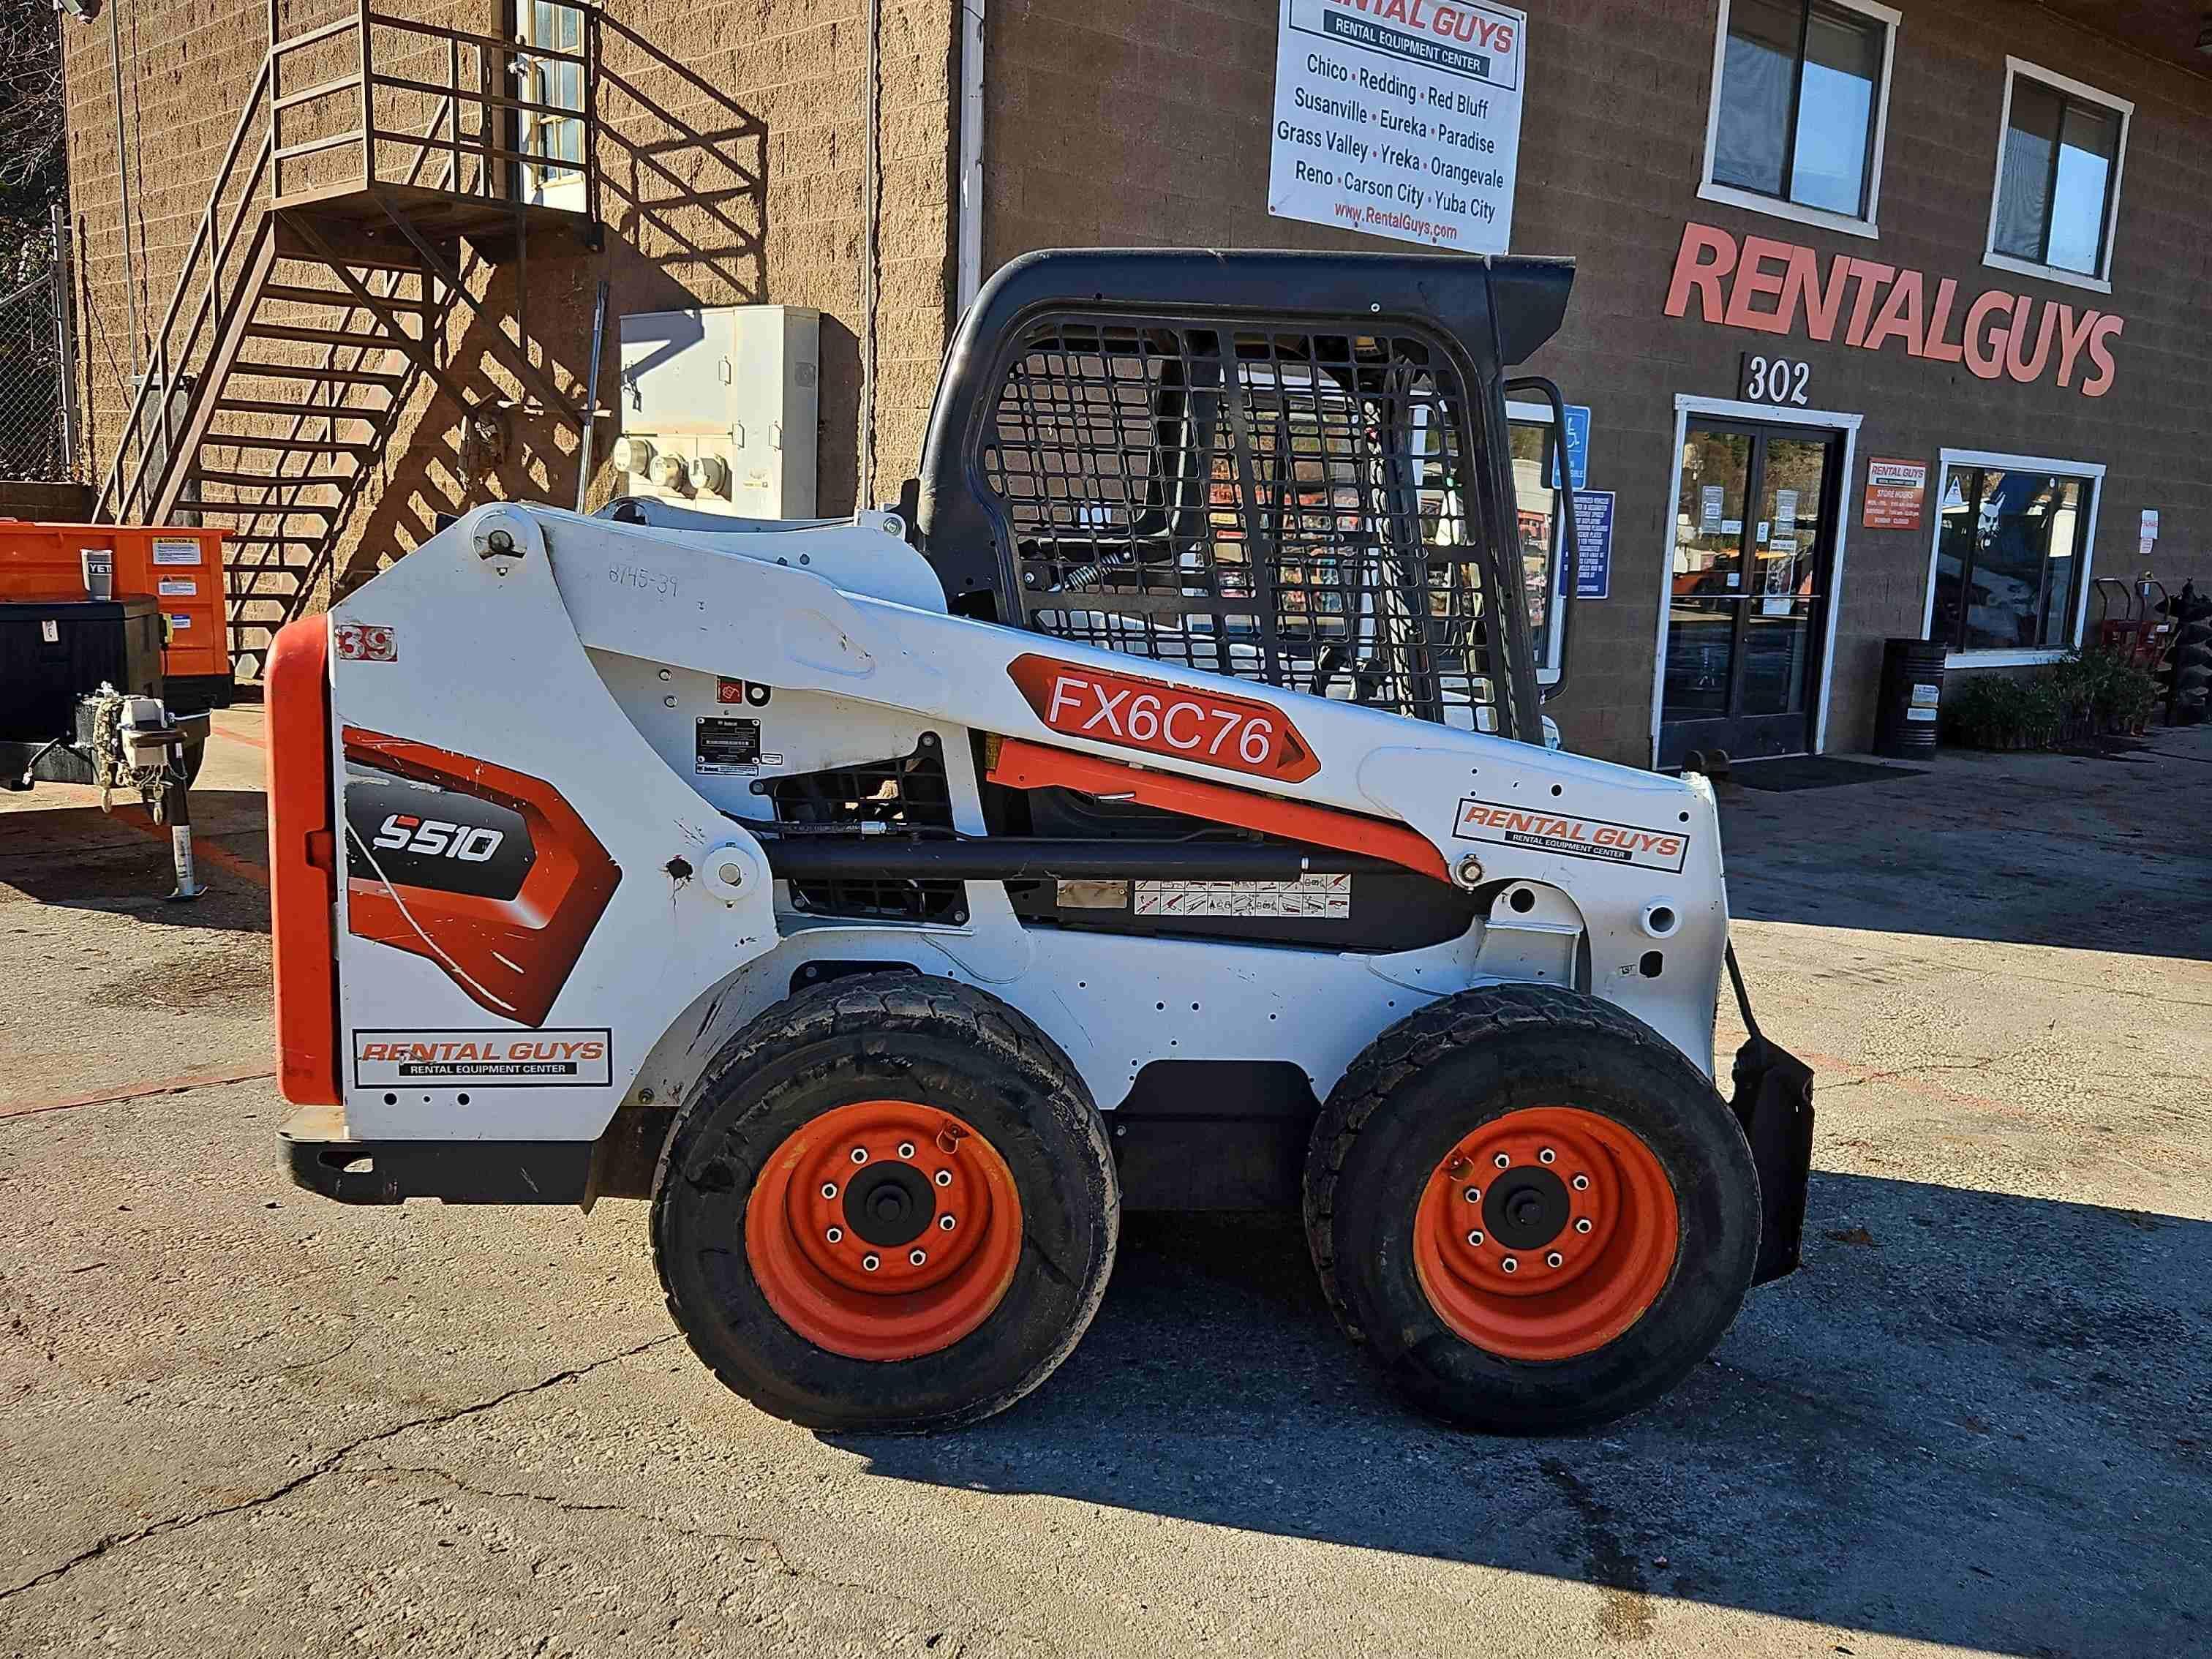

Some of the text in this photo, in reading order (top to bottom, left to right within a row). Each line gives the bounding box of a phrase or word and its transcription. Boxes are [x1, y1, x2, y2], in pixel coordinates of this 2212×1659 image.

[1335, 17, 1481, 72] RENTAL EQUIPMENT CENTER
[1433, 7, 1513, 53] GUYS
[1307, 53, 1489, 119] Chico Redding Red Bluff
[1295, 87, 1494, 154] Susanville Eureka Paradise
[1277, 121, 1504, 188] Grass Valley Yreka Orangevale
[1295, 160, 1495, 224] Reno Carson City Yuba City
[1334, 203, 1458, 240] www.RentalGuys.com
[1663, 222, 2123, 396] RENTAL GUYS
[1748, 356, 1810, 405] 302
[1872, 465, 1902, 477] RENTAL
[334, 626, 396, 660] 39
[1049, 677, 1274, 764] FX6C76
[373, 814, 504, 862] S510
[1464, 806, 1681, 856] RENTAL GUYS
[1512, 833, 1625, 859] RENTAL EQUIPMENT CENTER
[362, 1042, 604, 1062] RENTAL GUYS
[410, 1064, 566, 1075] RENTAL EQUIPMENT CENTER
